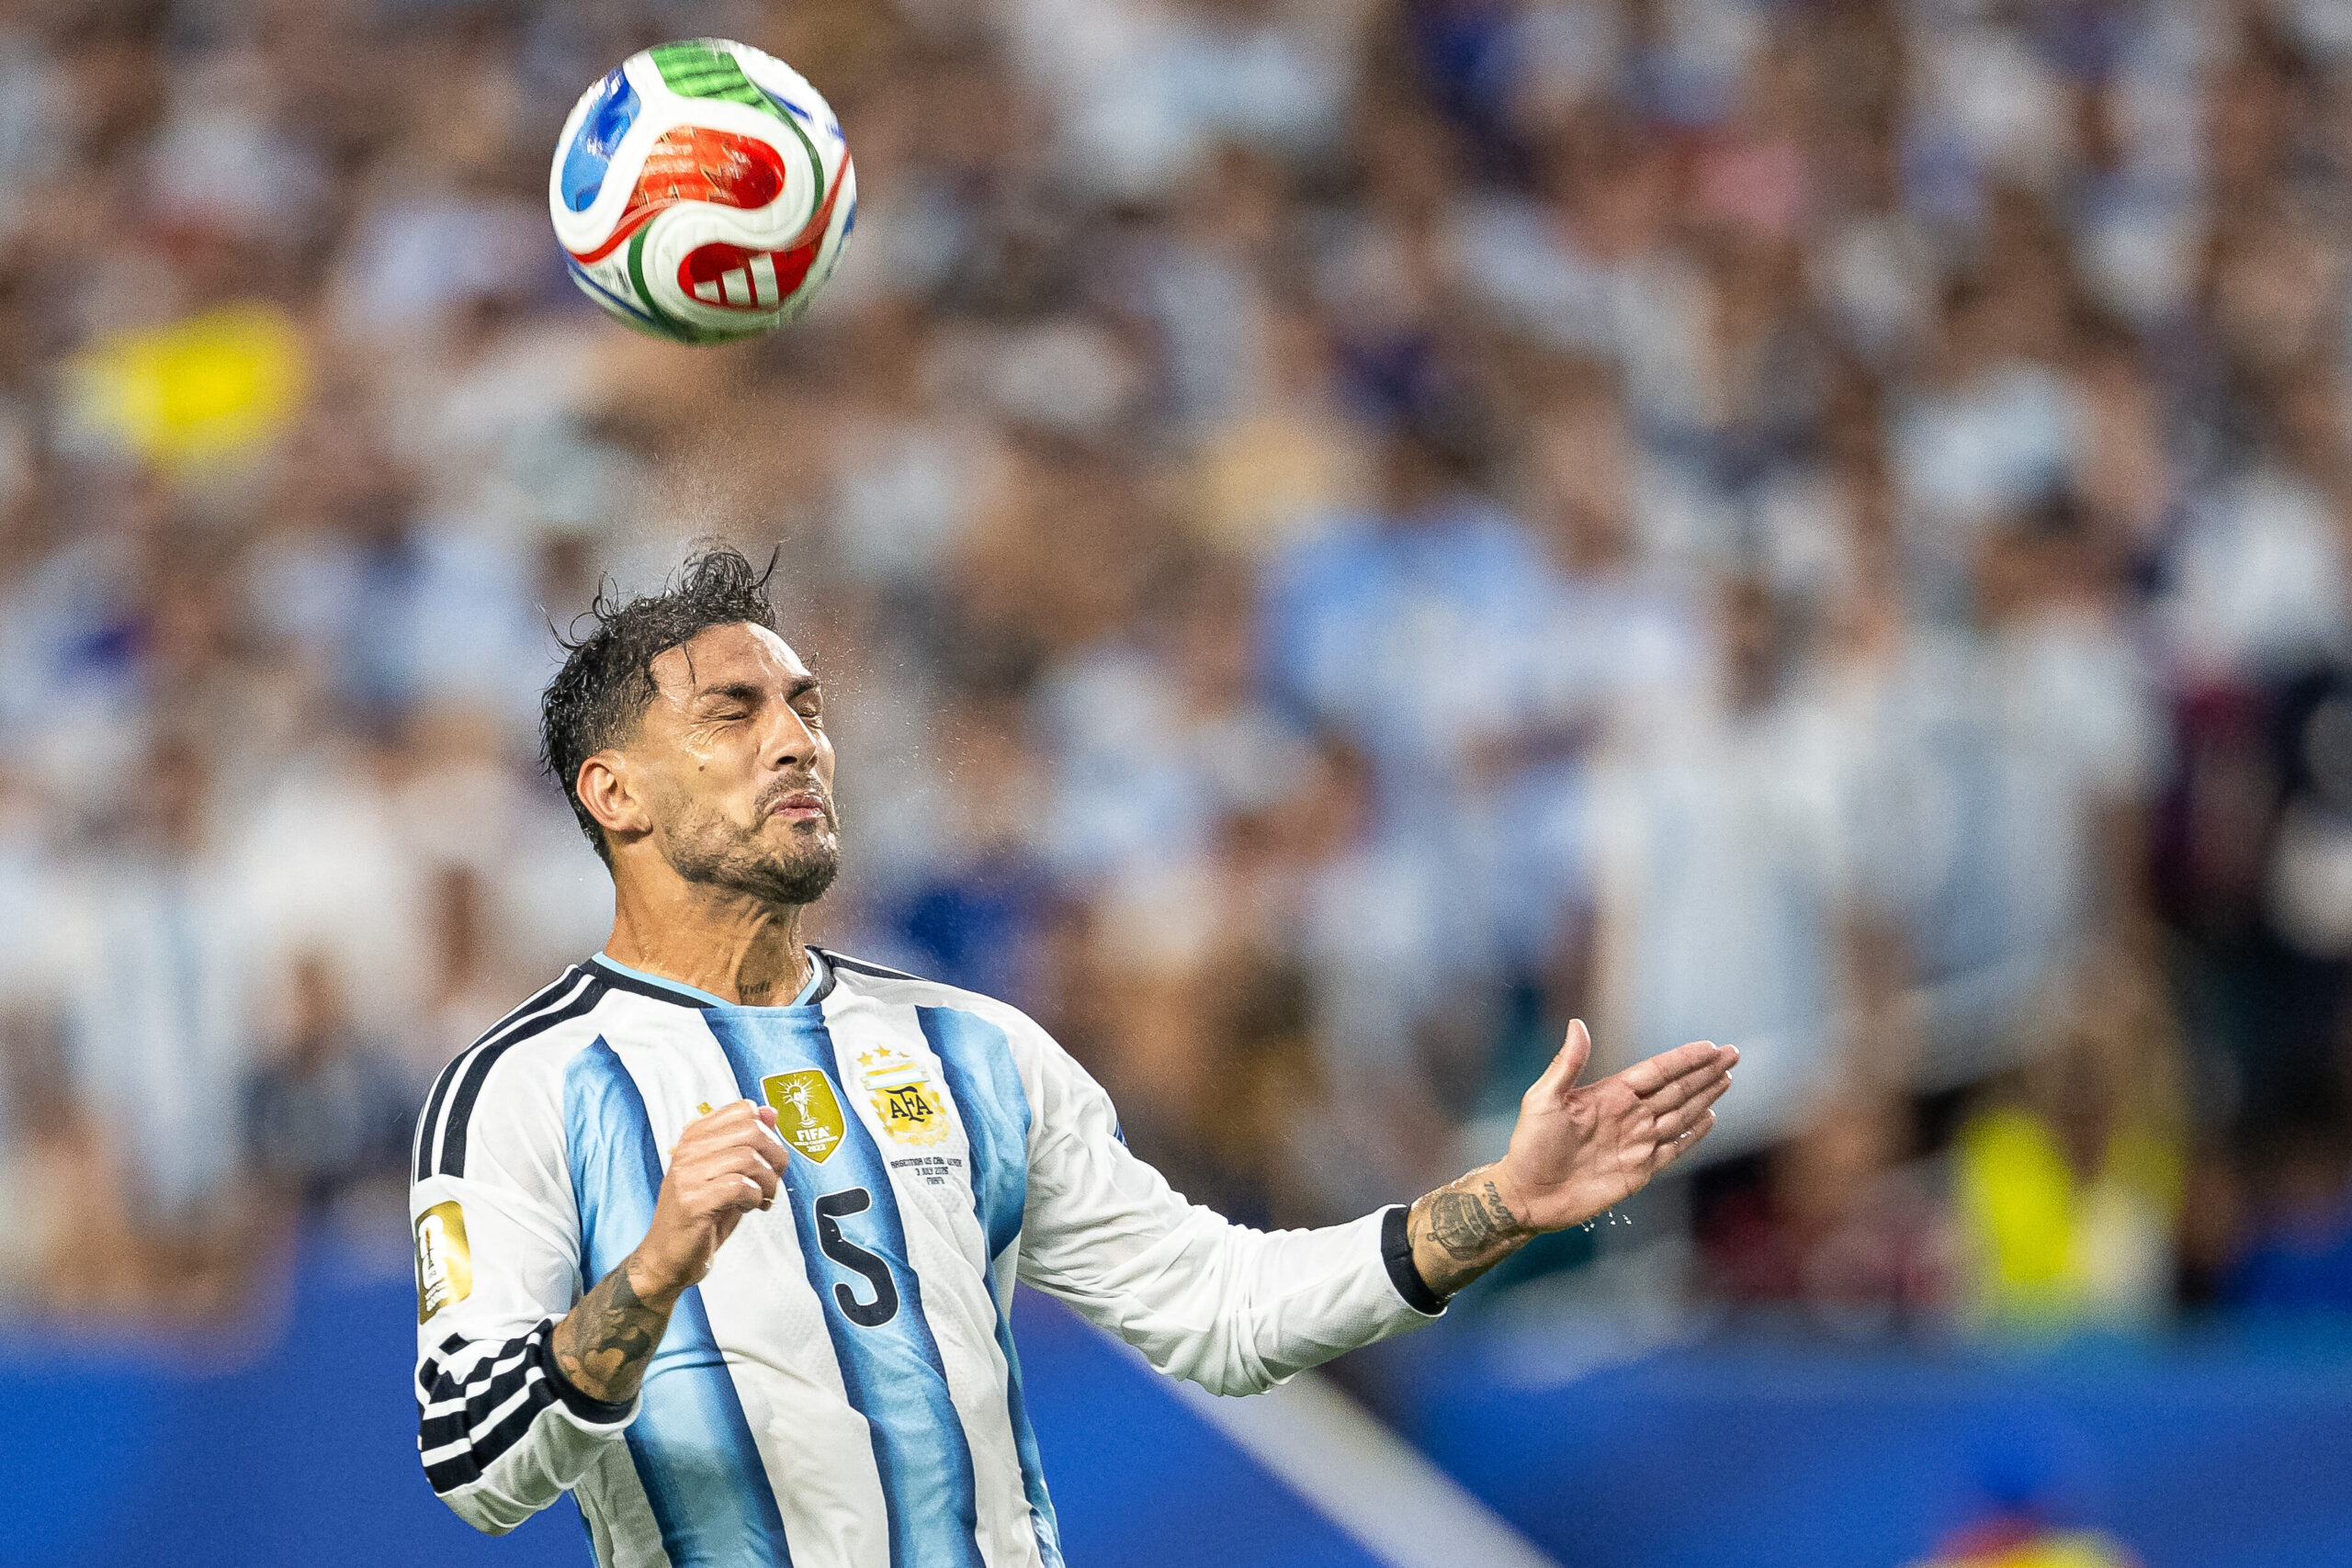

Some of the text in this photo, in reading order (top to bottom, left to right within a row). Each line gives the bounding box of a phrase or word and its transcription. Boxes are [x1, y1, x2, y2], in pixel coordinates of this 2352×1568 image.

[885, 1086, 933, 1122] AFA
[796, 1126, 831, 1142] FIFA
[815, 1188, 899, 1327] 5
